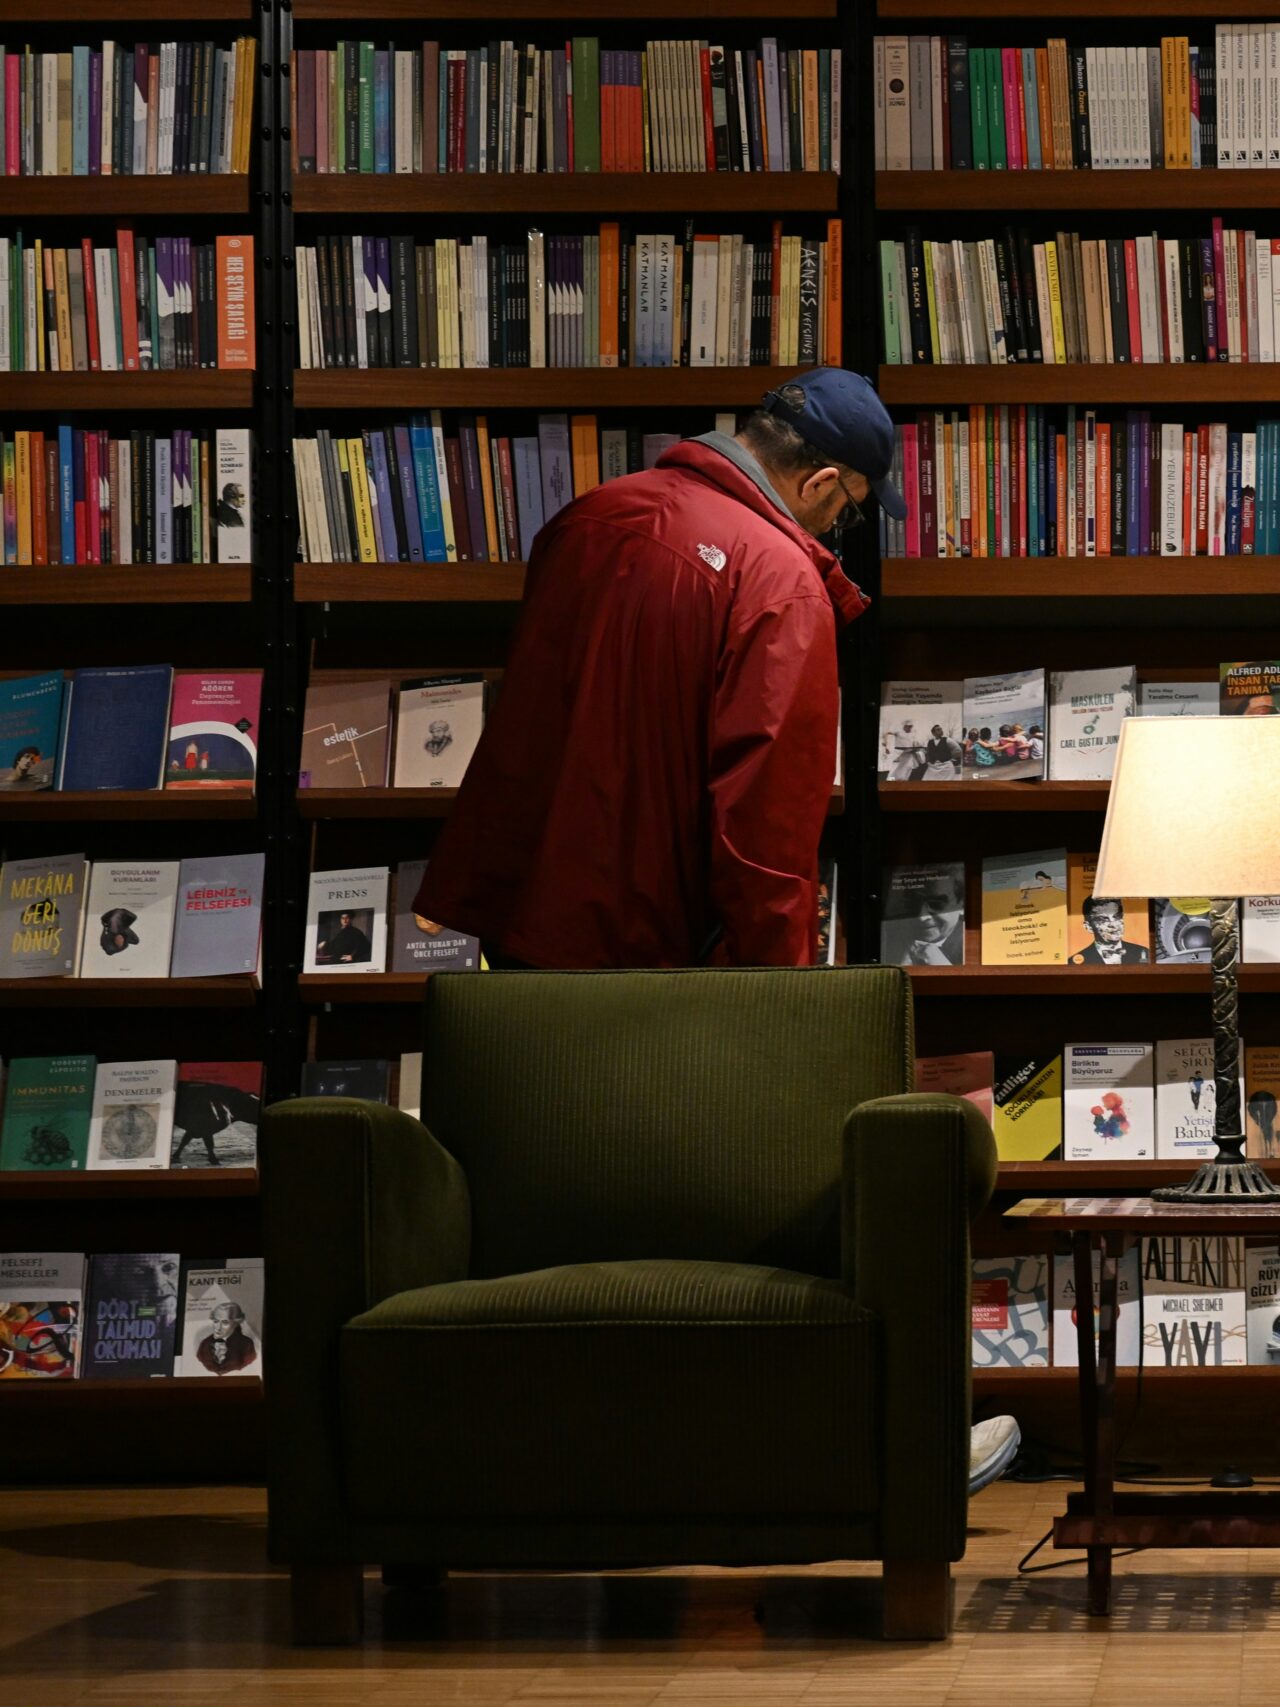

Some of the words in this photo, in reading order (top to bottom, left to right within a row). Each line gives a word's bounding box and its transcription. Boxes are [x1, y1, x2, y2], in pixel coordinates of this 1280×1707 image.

[226, 256, 244, 273] HER
[640, 242, 649, 313] KATMANLAR
[660, 241, 668, 312] KATMANLAR
[225, 275, 247, 303] ŞEYİN
[226, 304, 248, 340] ŞAFAĞI
[1167, 458, 1176, 481] YENİ
[1167, 483, 1176, 540] MÜZEBİLİM
[1227, 667, 1261, 676] ALFRED
[1227, 675, 1260, 685] İNSAN
[1227, 685, 1271, 696] TANIMA
[1070, 692, 1115, 708] MASKÜLEN
[322, 727, 360, 747] estetik
[1060, 738, 1077, 749] CARL
[1078, 737, 1104, 748] GUSTAV
[110, 869, 161, 877] DUYGULANIM
[113, 876, 157, 884] KURAMLARI
[10, 871, 75, 900] MEKÂNA
[187, 887, 236, 900] LEİBNİZ
[328, 888, 368, 900] PRENS
[22, 899, 57, 926] GERİ
[186, 898, 252, 912] FELSEFESİ
[12, 926, 65, 954] DÖNÜŞ
[433, 947, 459, 957] FELSEFE
[1071, 1060, 1100, 1068] Birlikte
[1071, 1067, 1114, 1076] Büyüyoruz
[104, 1087, 163, 1097] DENEMELER
[188, 1276, 217, 1287] KANT
[217, 1274, 243, 1287] ETİĞİ
[1251, 1283, 1278, 1297] GİZLİ
[97, 1299, 137, 1319] DÖRT
[1162, 1299, 1190, 1312] MICHAEL
[1192, 1298, 1224, 1312] SHERMER
[95, 1320, 157, 1340] TALMUD
[94, 1340, 162, 1360] OKUMASI
[1158, 1319, 1223, 1367] YAYI
